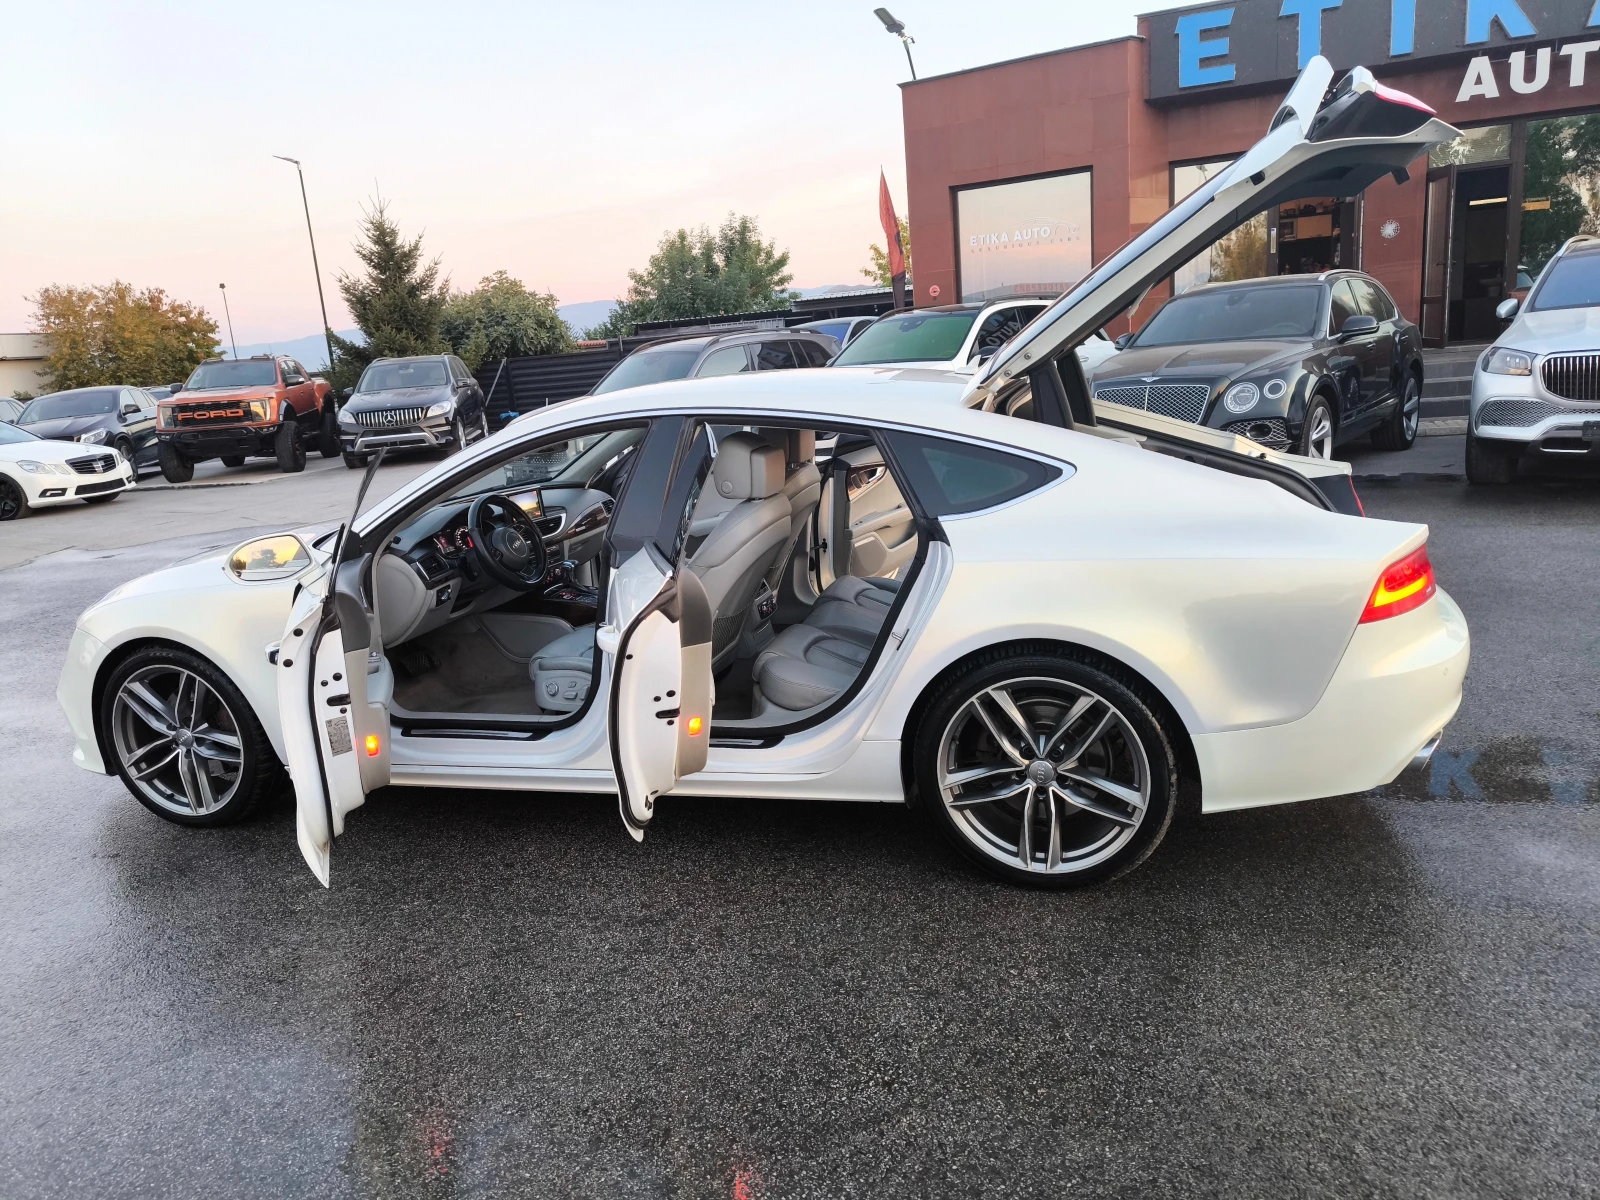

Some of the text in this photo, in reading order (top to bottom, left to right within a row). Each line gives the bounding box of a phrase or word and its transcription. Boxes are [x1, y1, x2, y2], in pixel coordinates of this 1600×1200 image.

[1175, 0, 1600, 89] ETIK
[969, 226, 1051, 247] ETIKA AUTO
[971, 235, 1080, 253] LUXURIOUS CARS
[177, 409, 244, 420] FORD
